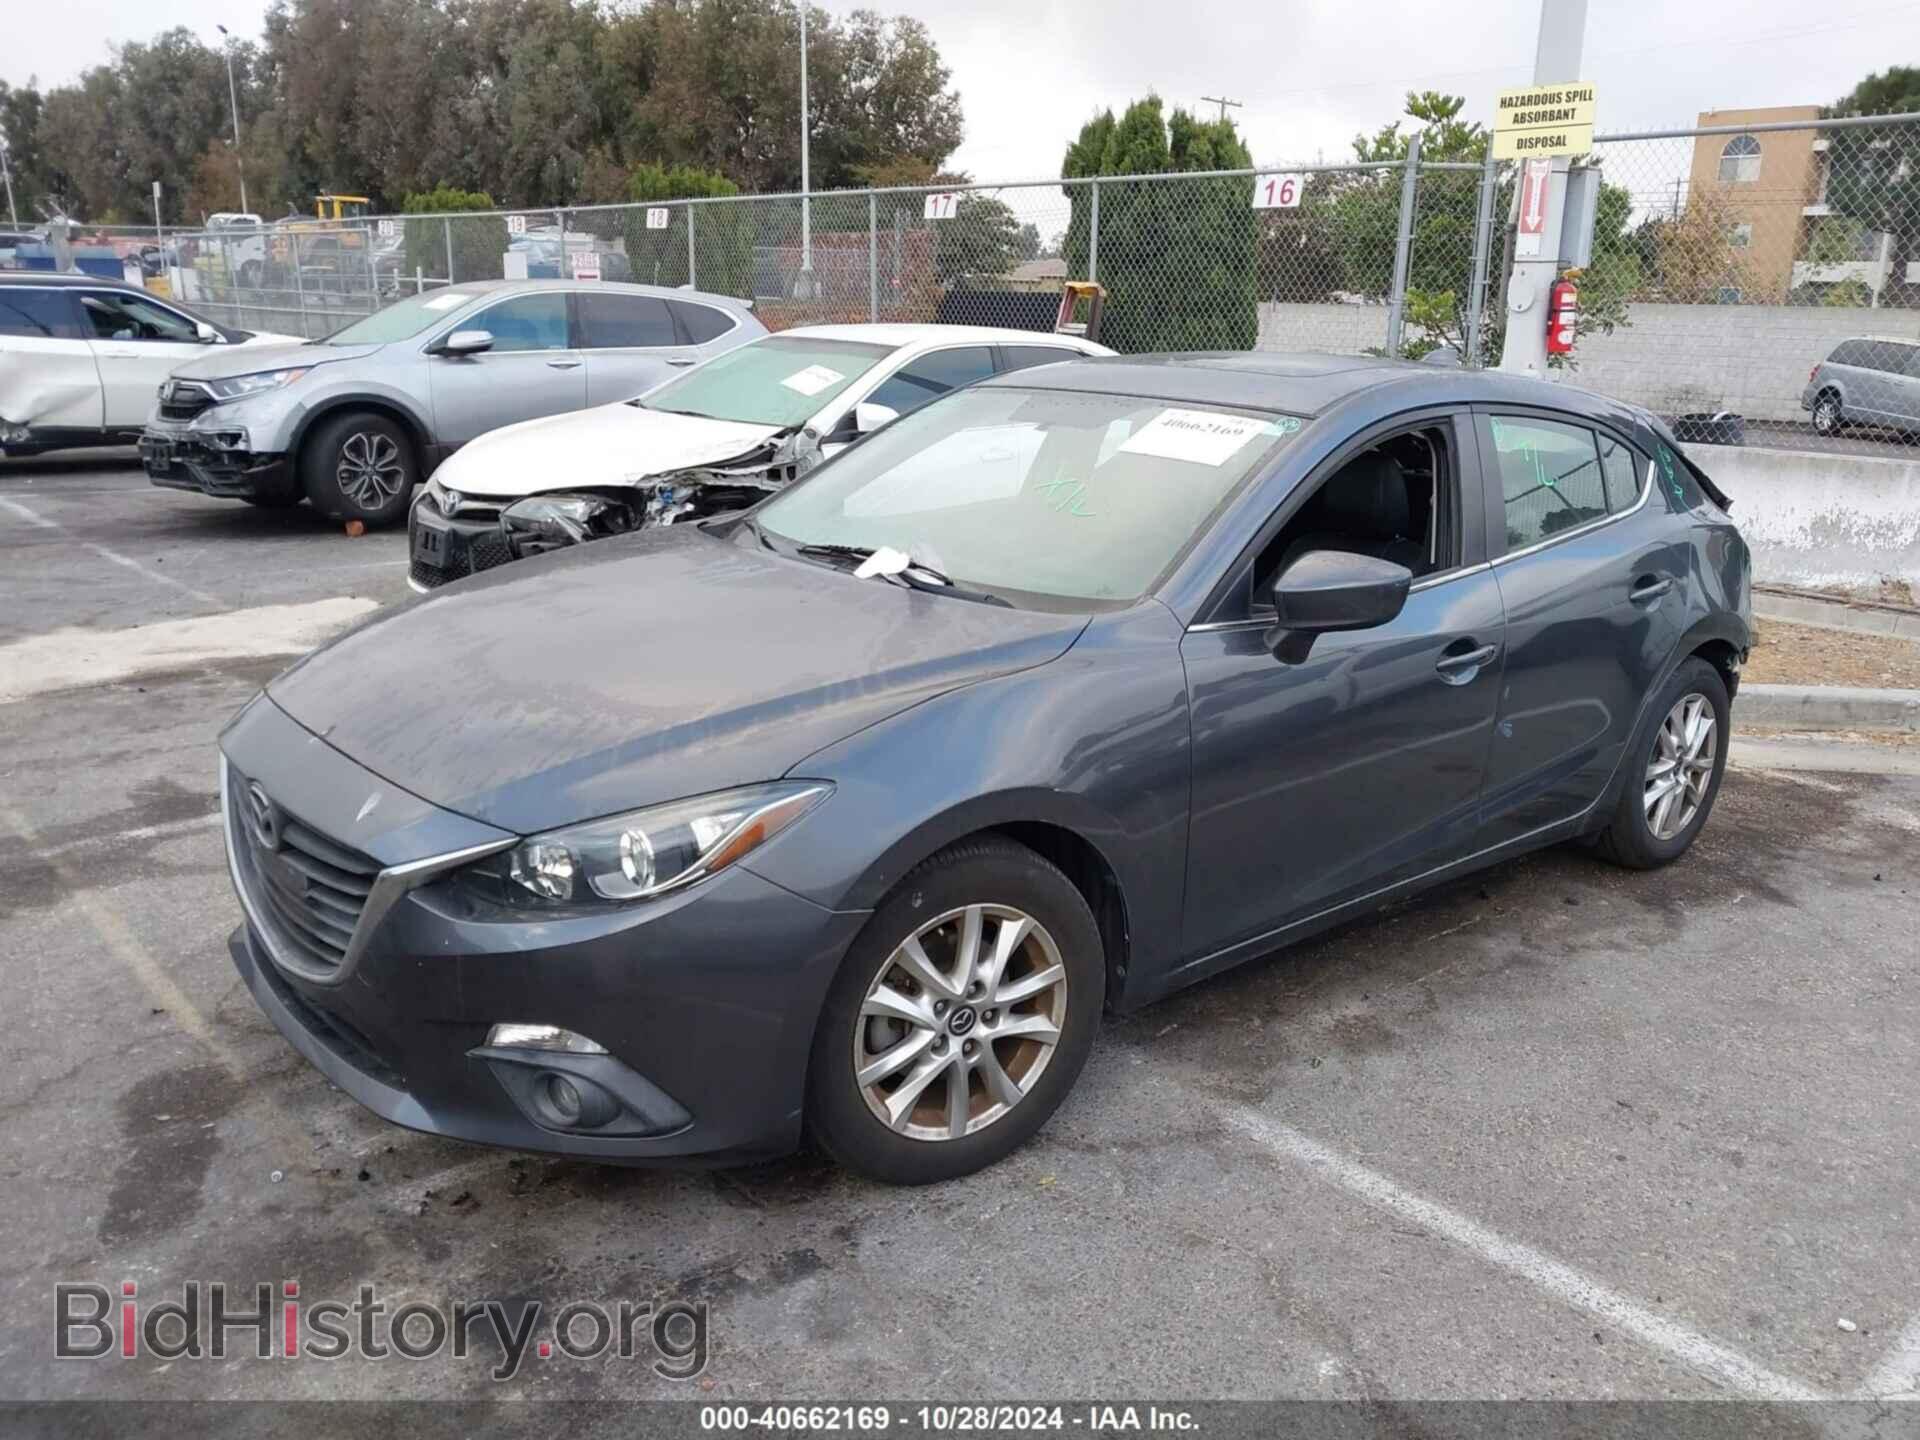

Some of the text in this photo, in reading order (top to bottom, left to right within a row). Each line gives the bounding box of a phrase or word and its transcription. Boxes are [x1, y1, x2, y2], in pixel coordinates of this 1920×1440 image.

[1500, 89, 1593, 109] HAZARDOUS SPILL
[1512, 108, 1577, 125] ABSORBANT
[1516, 134, 1567, 150] DISPOSAL
[1265, 179, 1295, 206] 16
[931, 195, 953, 217] 17
[650, 210, 664, 226] 18
